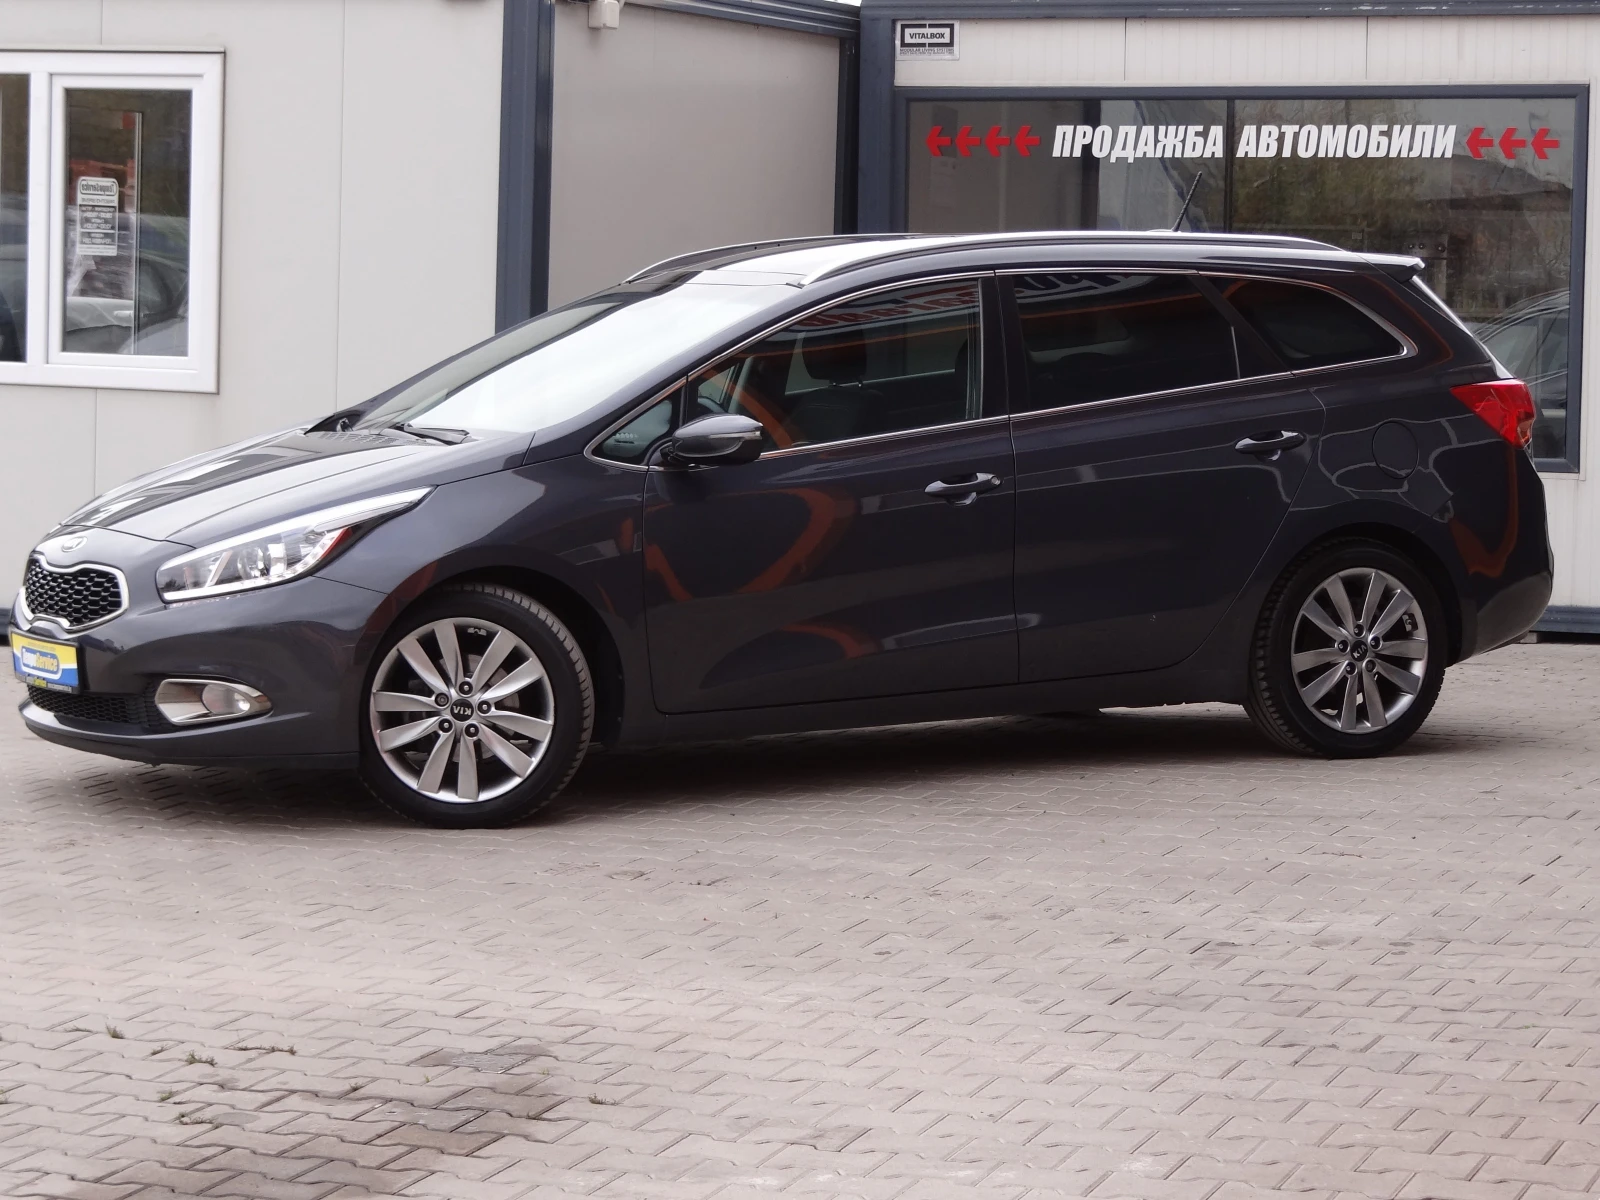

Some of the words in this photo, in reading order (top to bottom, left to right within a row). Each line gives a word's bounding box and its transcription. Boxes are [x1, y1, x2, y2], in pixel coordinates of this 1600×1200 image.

[909, 32, 945, 40] VITALBOX
[1051, 124, 1224, 163] ПРОДАЖБА
[1236, 124, 1457, 159] АВТОМОБИЛИ
[1353, 645, 1367, 659] KIA
[452, 705, 472, 716] KIA
